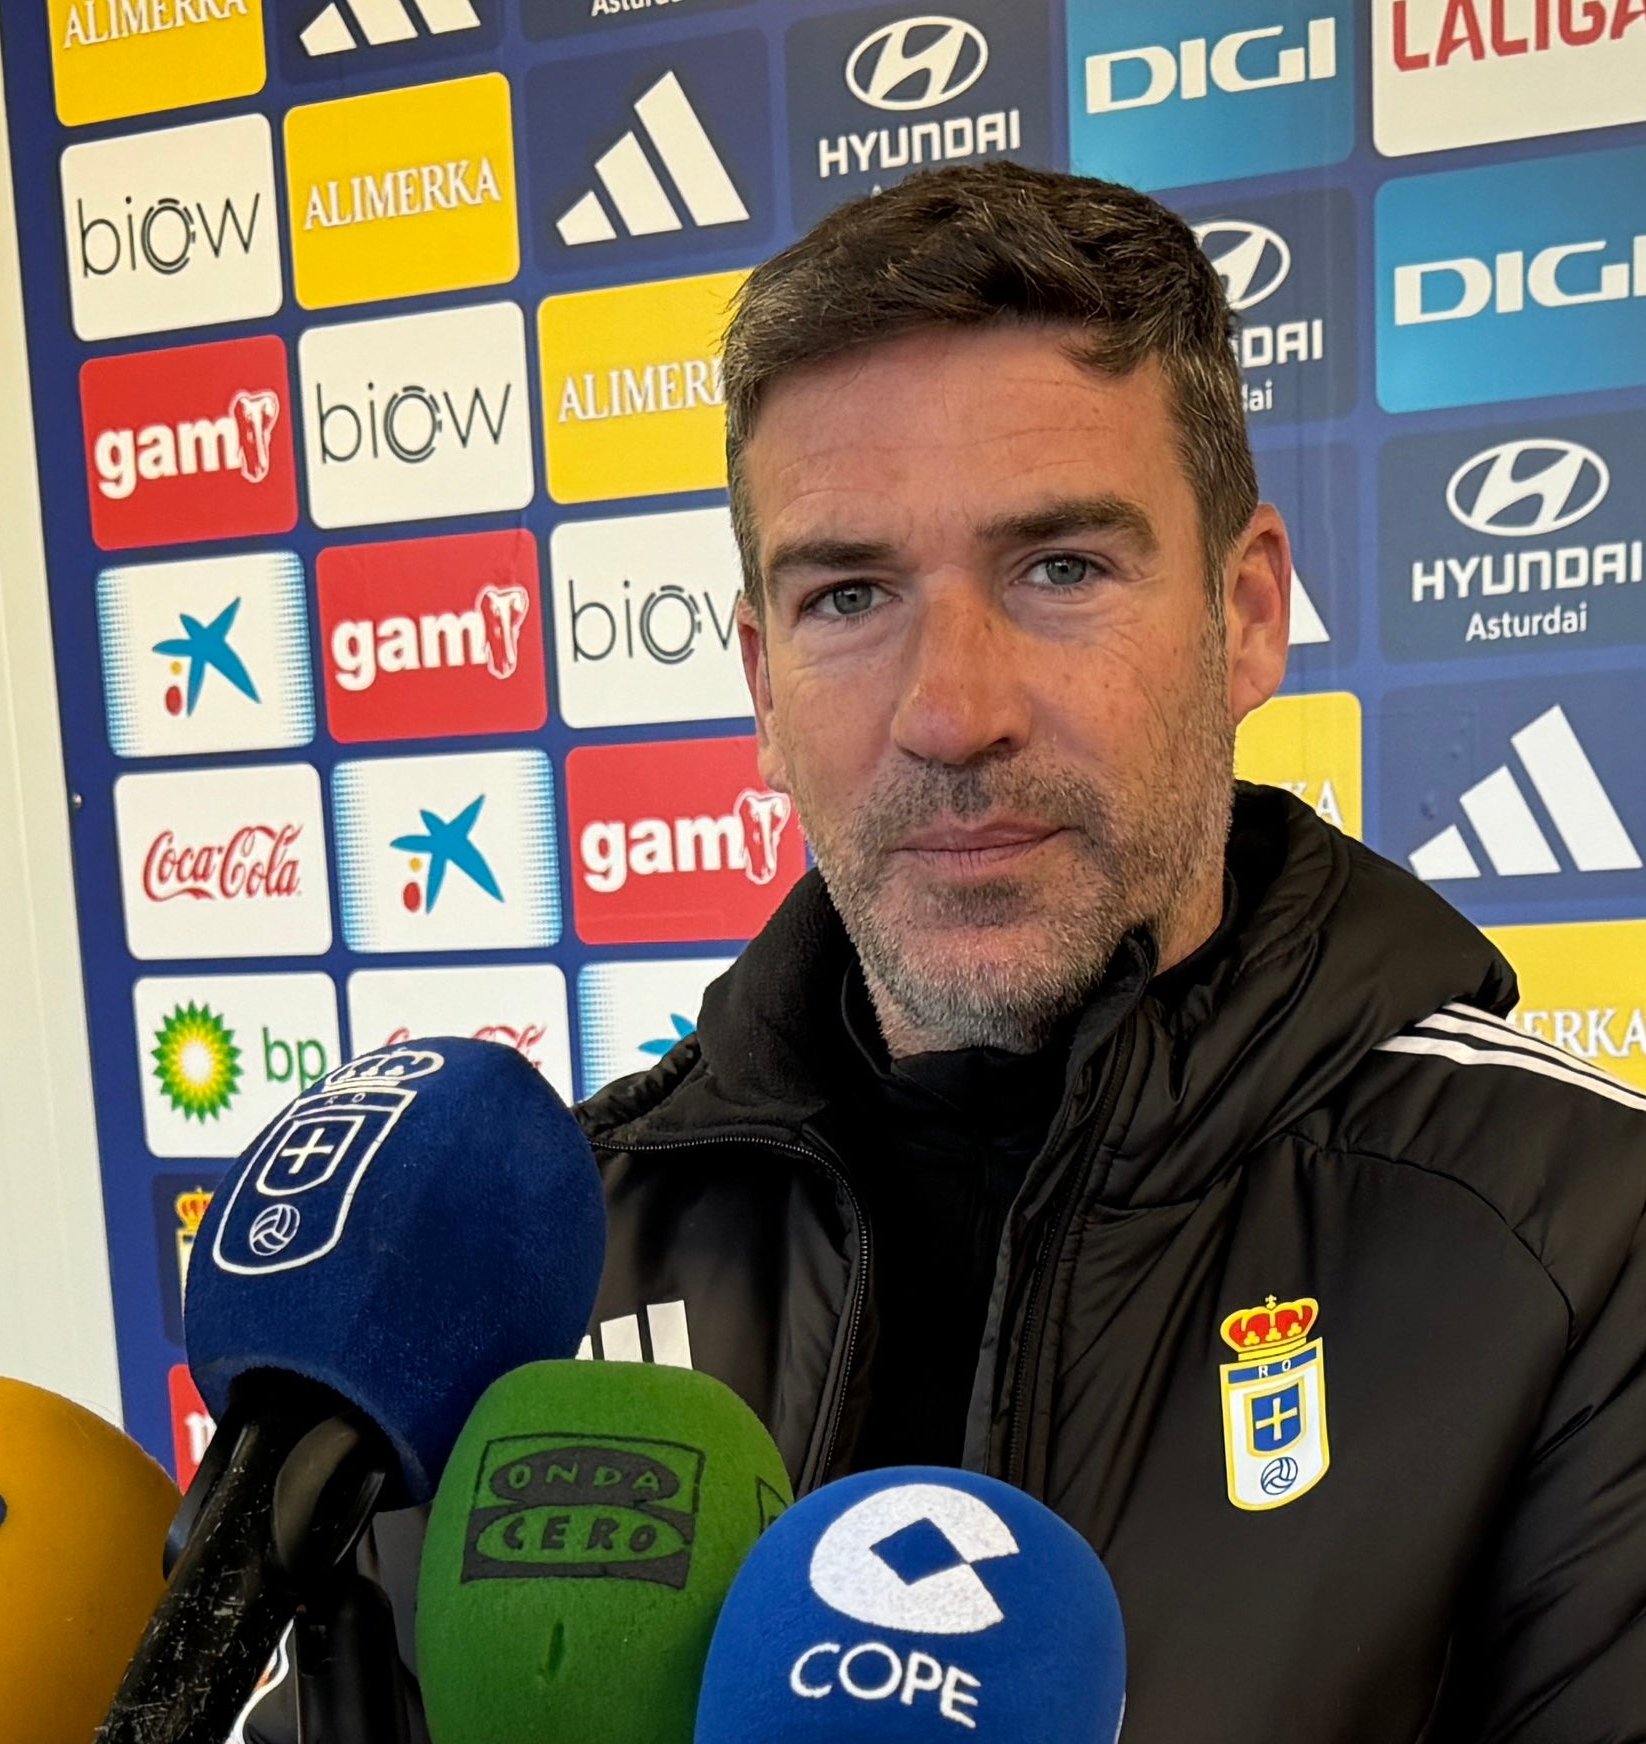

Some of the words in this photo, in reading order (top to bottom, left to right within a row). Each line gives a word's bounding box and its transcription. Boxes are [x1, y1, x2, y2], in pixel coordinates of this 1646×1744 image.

[1085, 17, 1337, 115] DIGI
[818, 109, 1021, 178] HYUNDAI
[303, 156, 501, 231] ALIMERKA
[1411, 541, 1643, 602] HYUNDAI
[1464, 603, 1588, 643] Asturdai
[142, 823, 302, 902] Coca-Cola
[263, 1027, 328, 1091] bp
[507, 1463, 662, 1492] ONDA
[503, 1516, 657, 1552] CERO
[790, 1643, 981, 1728] COPE
